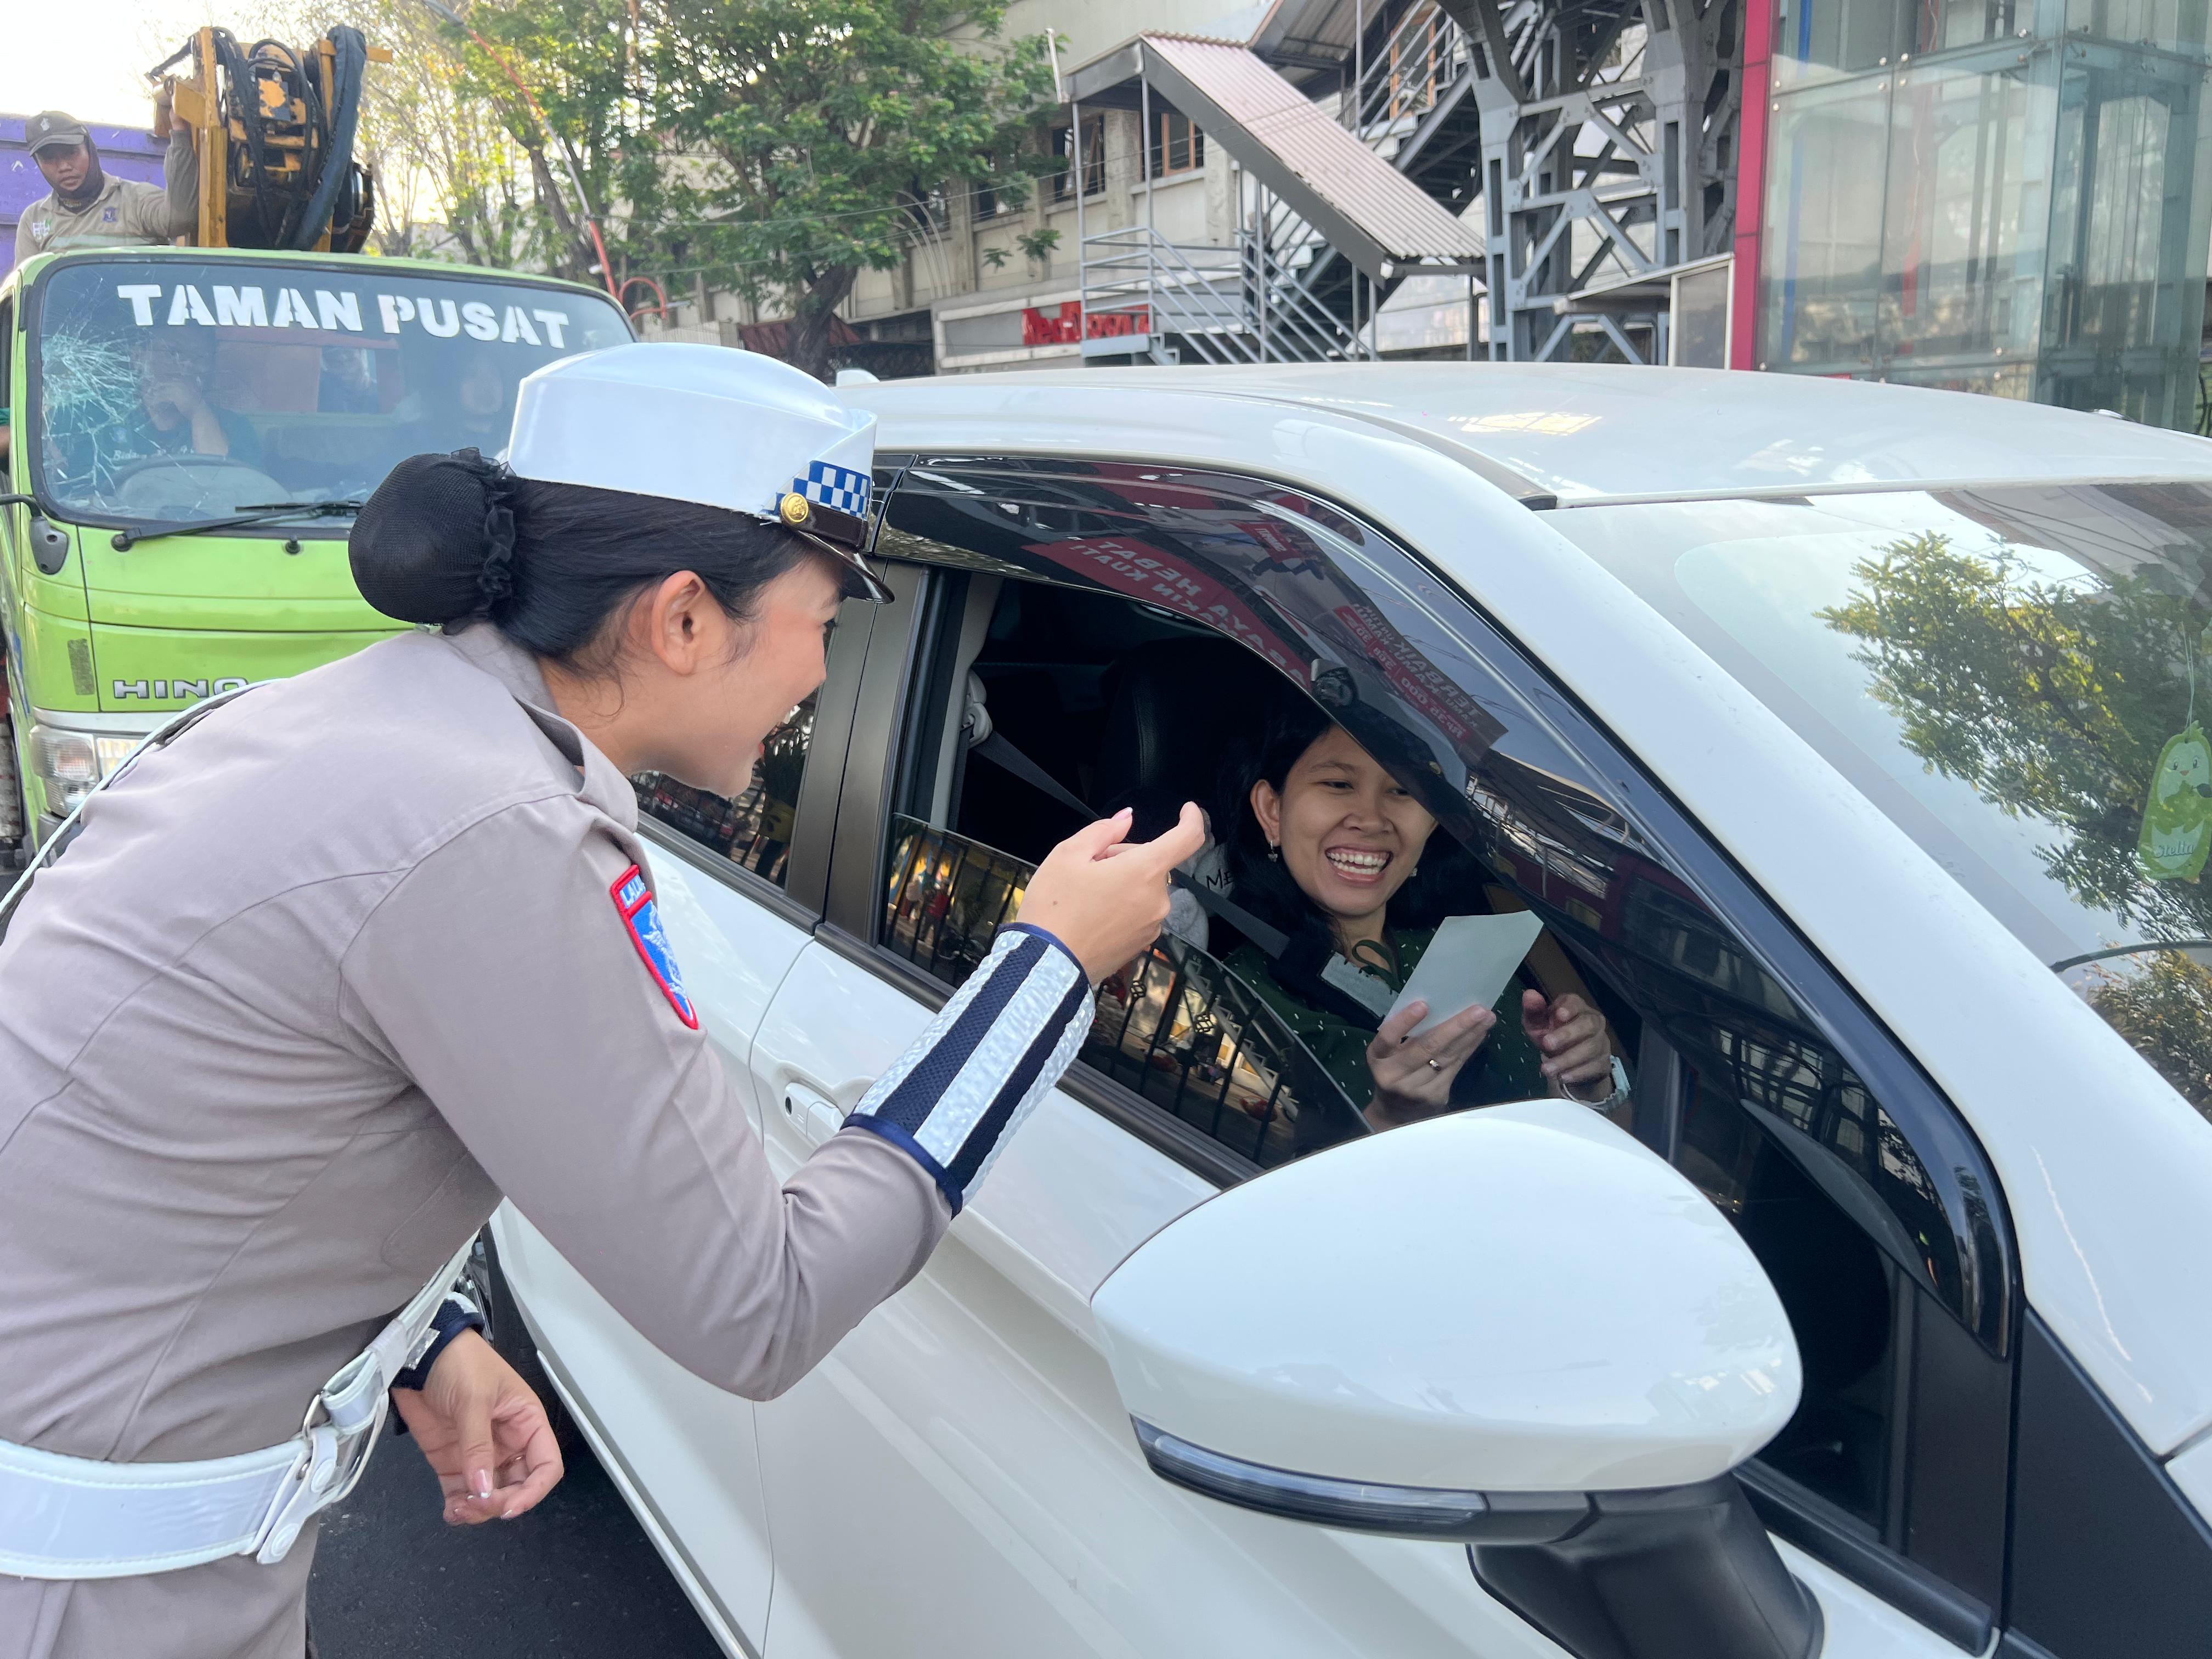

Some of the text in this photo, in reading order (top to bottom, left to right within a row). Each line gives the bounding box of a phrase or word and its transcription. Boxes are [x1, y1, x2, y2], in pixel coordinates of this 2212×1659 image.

[117, 284, 569, 349] TAMAN PUSAT
[113, 677, 248, 699] HINO
[2154, 840, 2196, 858] Stella
[1206, 868, 1234, 889] ME
